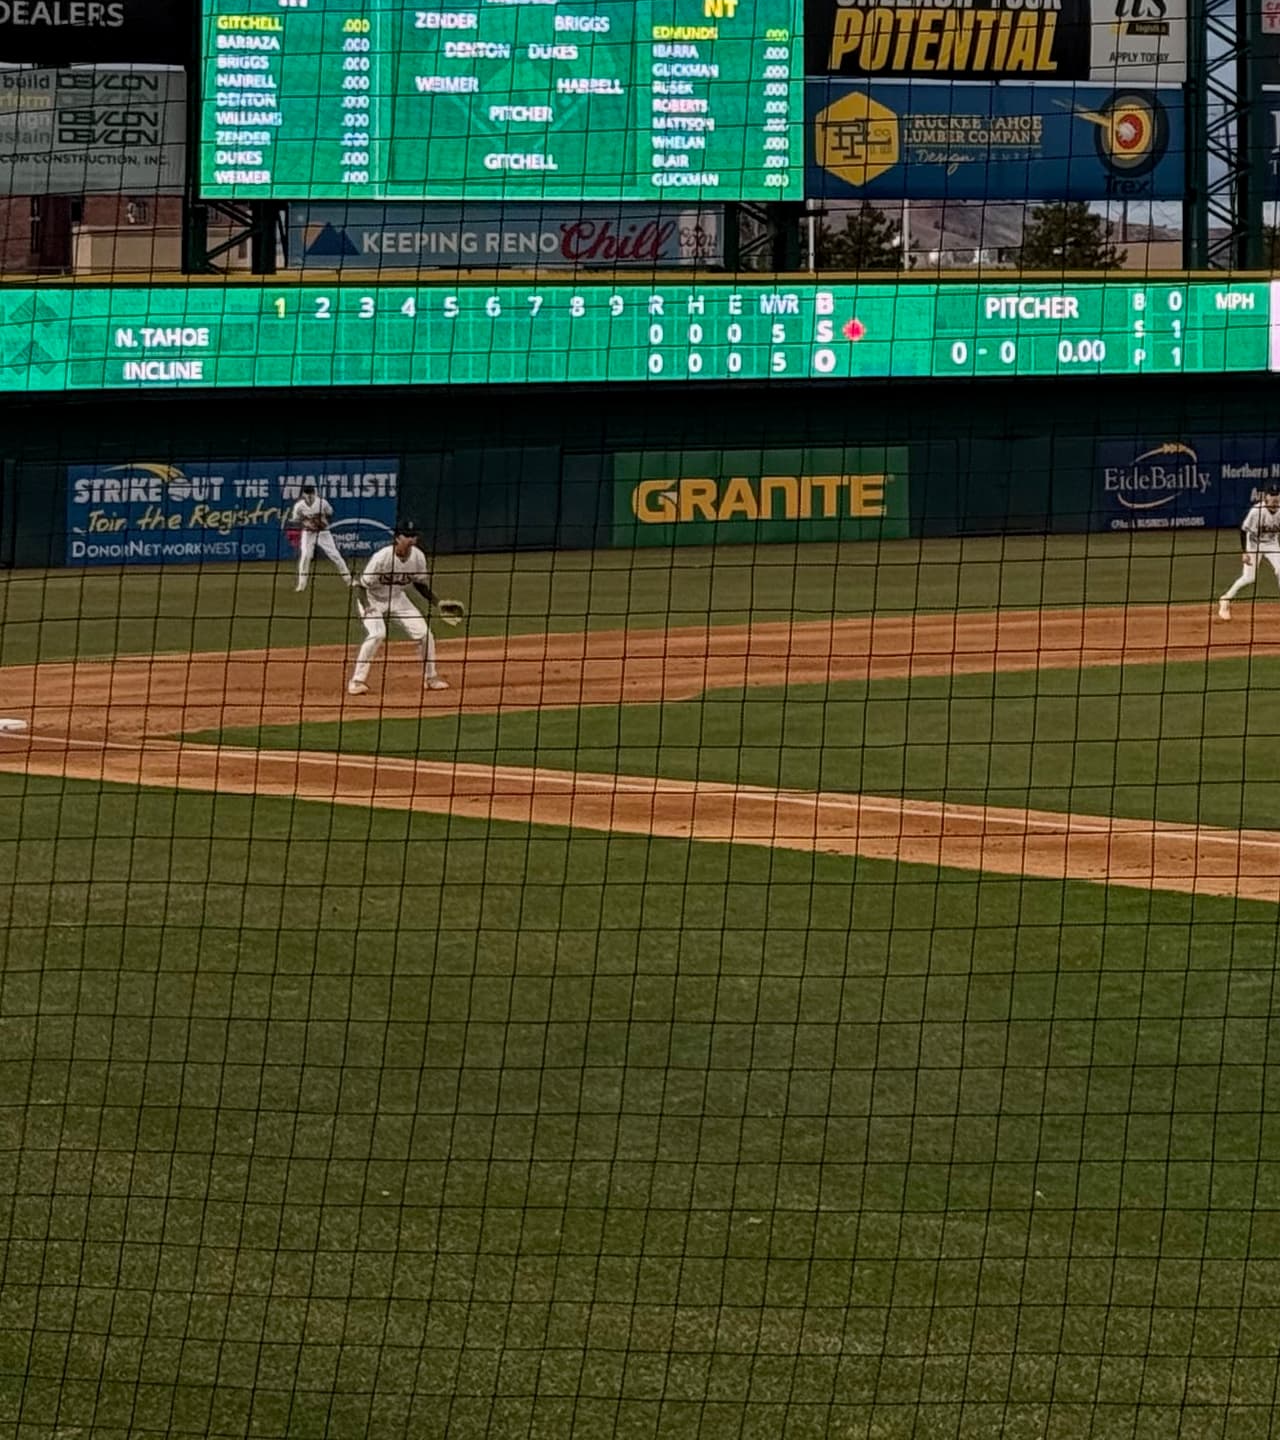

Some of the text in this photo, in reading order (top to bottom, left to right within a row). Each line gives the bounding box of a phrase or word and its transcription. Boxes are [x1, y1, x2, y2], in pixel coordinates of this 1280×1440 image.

[217, 16, 283, 31] GITCHELL
[415, 12, 478, 29] ZENDER
[554, 16, 610, 32] BRIGGS
[652, 26, 718, 40] EDMUNDS
[827, 8, 1058, 71] POTENTIAL
[444, 42, 510, 59] DENTON
[528, 44, 579, 60] DUKES
[1109, 51, 1170, 63] APPLY TODAY
[216, 55, 269, 70] BRIGGS
[652, 63, 719, 78] GLICKMAN
[3, 74, 158, 91] build DEVCON
[415, 76, 479, 93] WEIMER
[556, 78, 624, 95] HARRELL
[489, 106, 553, 122] PITCHER
[652, 99, 708, 113] ROBERTS
[58, 110, 158, 127] DEVCON
[215, 112, 283, 126] WILLIAMS
[902, 114, 1042, 129] TRUCKEE TAHOE
[58, 128, 158, 145] DEVCON
[652, 135, 705, 150] WHELAN
[904, 129, 1042, 143] LUMBER COMPANY
[215, 150, 263, 165] DUKES
[484, 153, 558, 170] GITCHELL
[652, 154, 689, 168] BLAIR
[651, 172, 719, 187] GLICKMAN
[1104, 175, 1150, 195] Trex
[363, 231, 477, 254] KEEPING
[485, 231, 560, 254] RENO
[559, 221, 678, 261] Chill
[274, 297, 286, 318] 1
[315, 297, 331, 318] 2
[358, 297, 375, 318] 3
[401, 297, 417, 318] 4
[443, 297, 459, 318] 5
[486, 296, 502, 317] 6
[527, 296, 544, 317] 7
[569, 296, 585, 317] 8
[648, 295, 665, 316] R
[688, 295, 704, 316] H
[728, 295, 743, 316] E
[815, 293, 834, 315] B
[984, 296, 1079, 319] PITCHER
[1168, 291, 1183, 311] 0
[1215, 292, 1255, 310] MPH
[115, 323, 785, 348] N. TAHOE 0 0 0 5
[816, 320, 834, 343] S
[1171, 319, 1182, 338] 1
[1058, 339, 1106, 363] 0.00
[1171, 347, 1182, 366] 1
[123, 352, 786, 380] INCLINE 0 0 0 5
[1222, 463, 1268, 479] Northern
[73, 472, 397, 504] STRIKE OUT THE WAITLIST!
[631, 474, 888, 524] GRANITE
[137, 505, 182, 531] the
[189, 499, 291, 535] Registry
